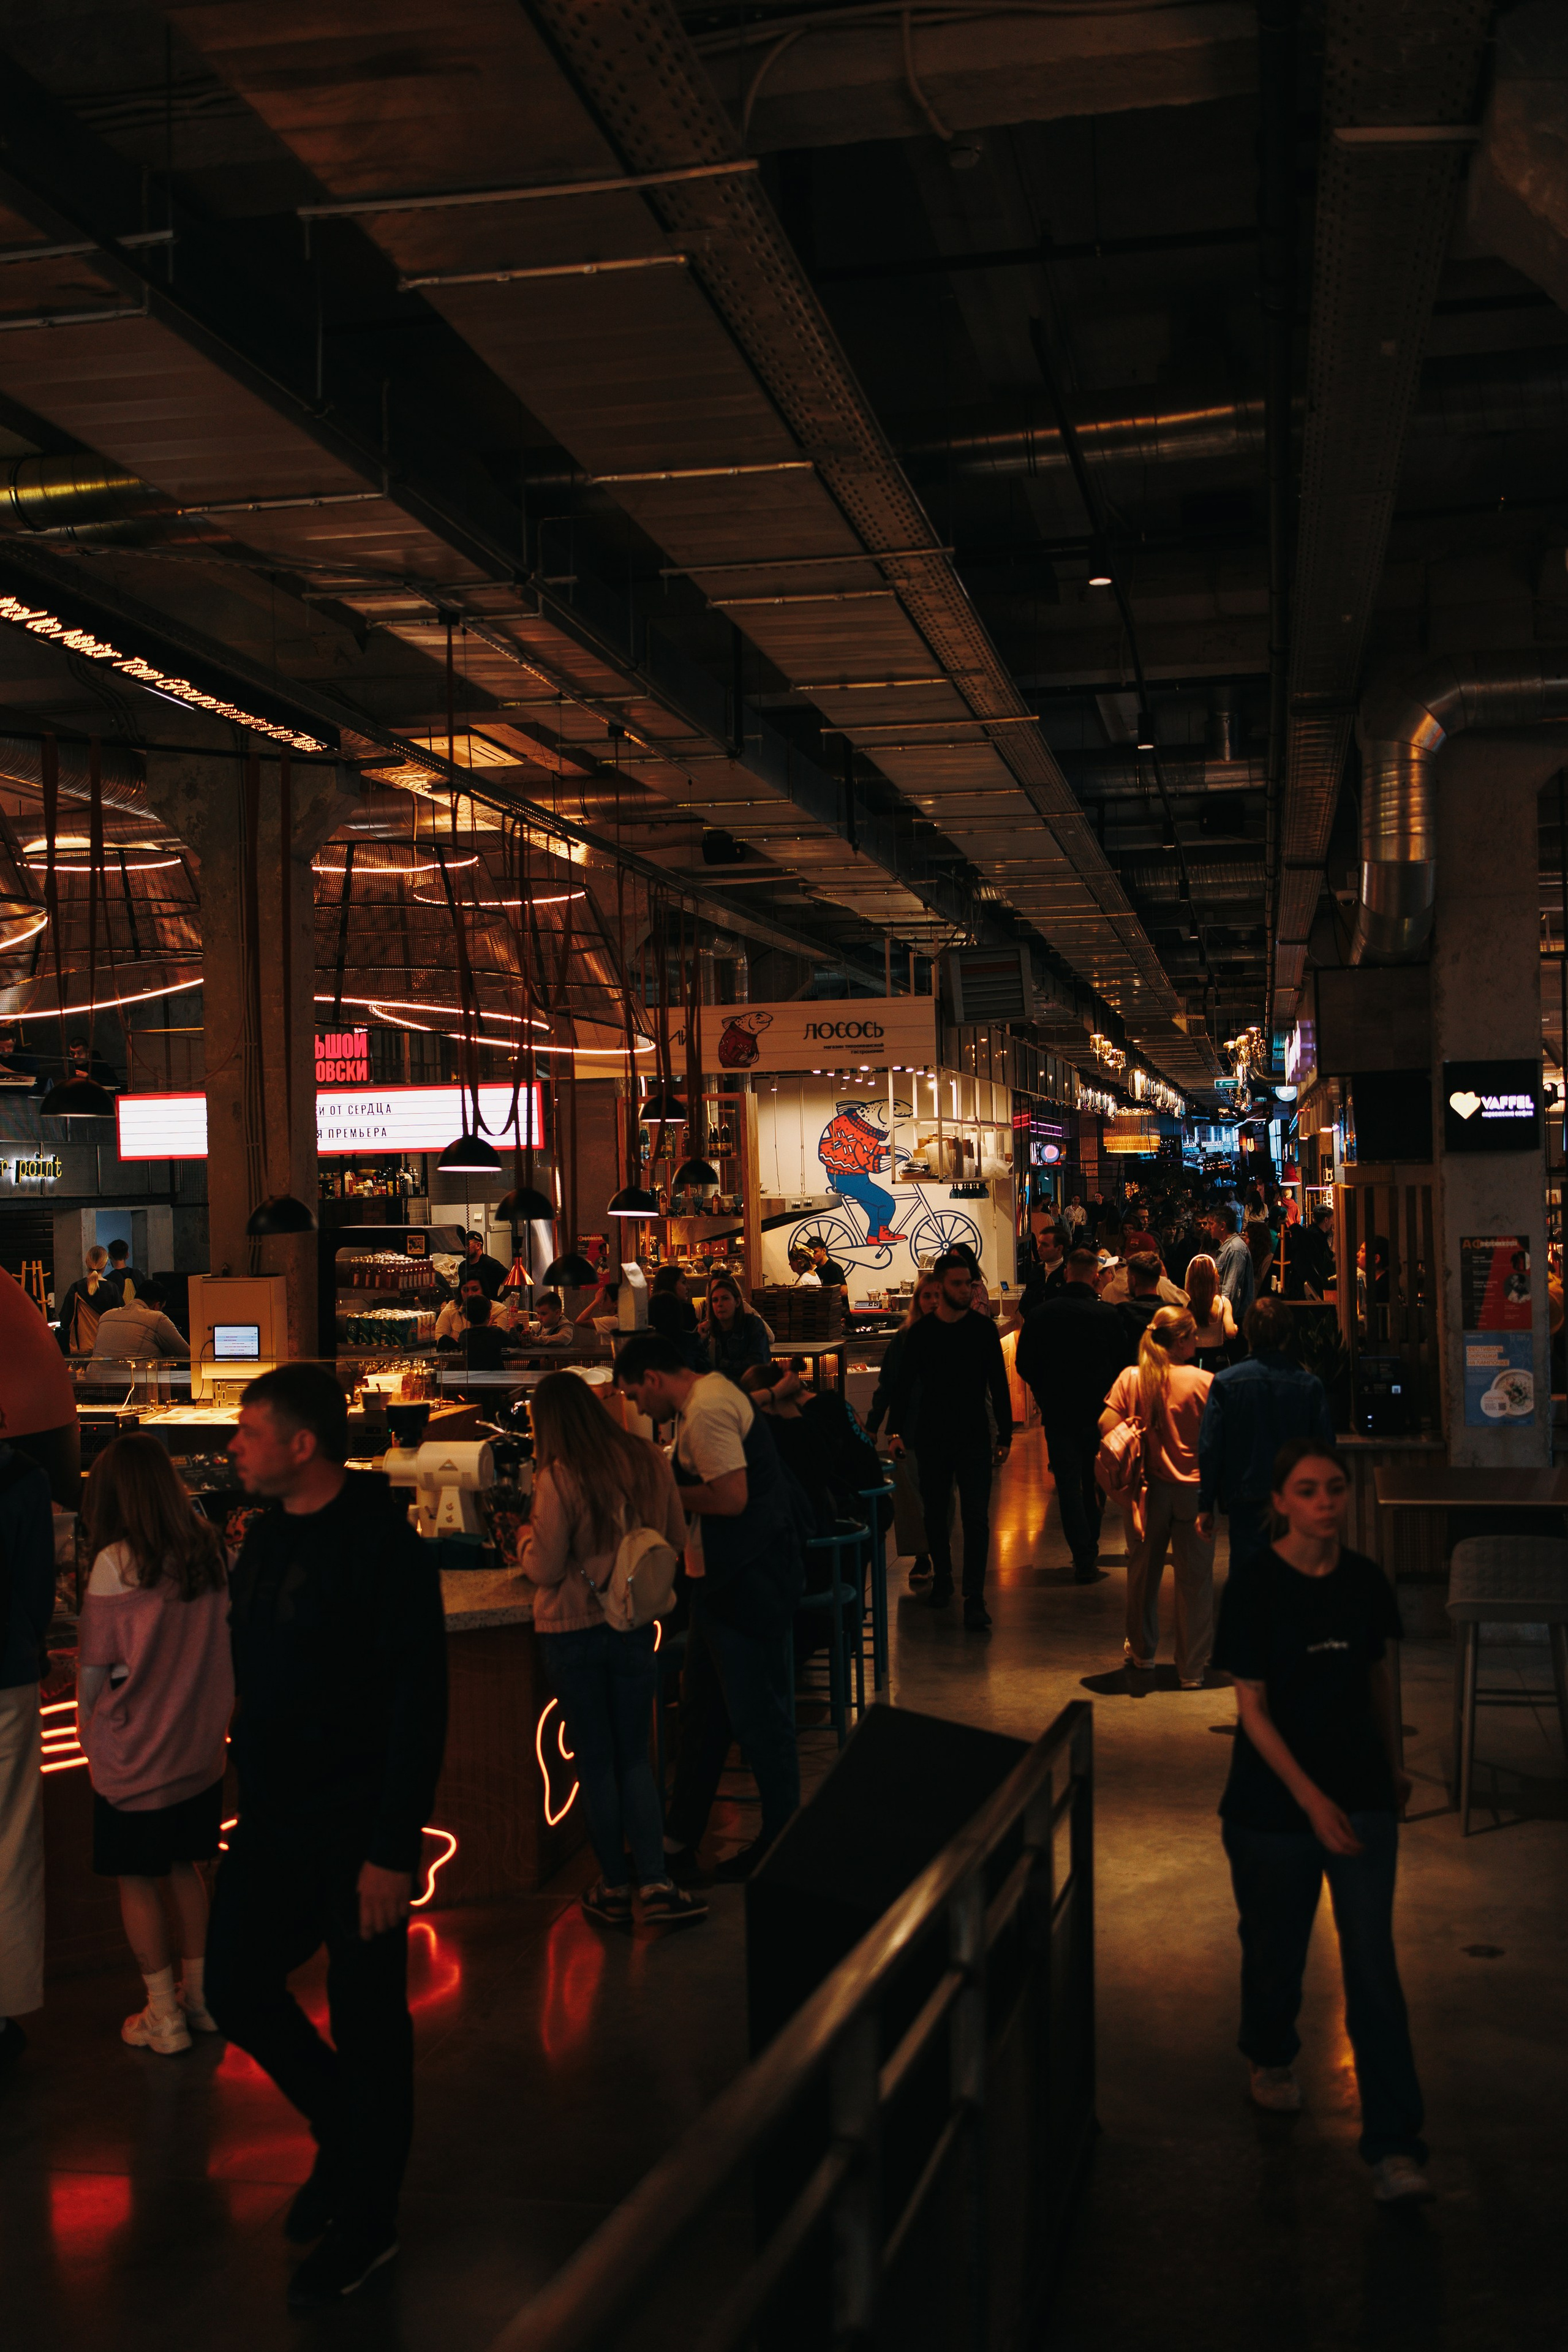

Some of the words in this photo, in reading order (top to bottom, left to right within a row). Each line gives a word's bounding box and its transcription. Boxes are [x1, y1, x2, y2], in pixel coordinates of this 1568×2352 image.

[112, 657, 164, 680] Tom
[156, 679, 235, 709] Ground
[216, 708, 284, 731] control
[803, 1021, 884, 1040] ЛОСОСЬ
[315, 1060, 368, 1082] ОВСКИ
[330, 1105, 342, 1115] ОТ
[348, 1102, 391, 1115] СЕРДЦА
[1480, 1095, 1535, 1110] VAFFEL
[328, 1127, 386, 1138] ПРЕМЬЕРА
[19, 1153, 62, 1183] point
